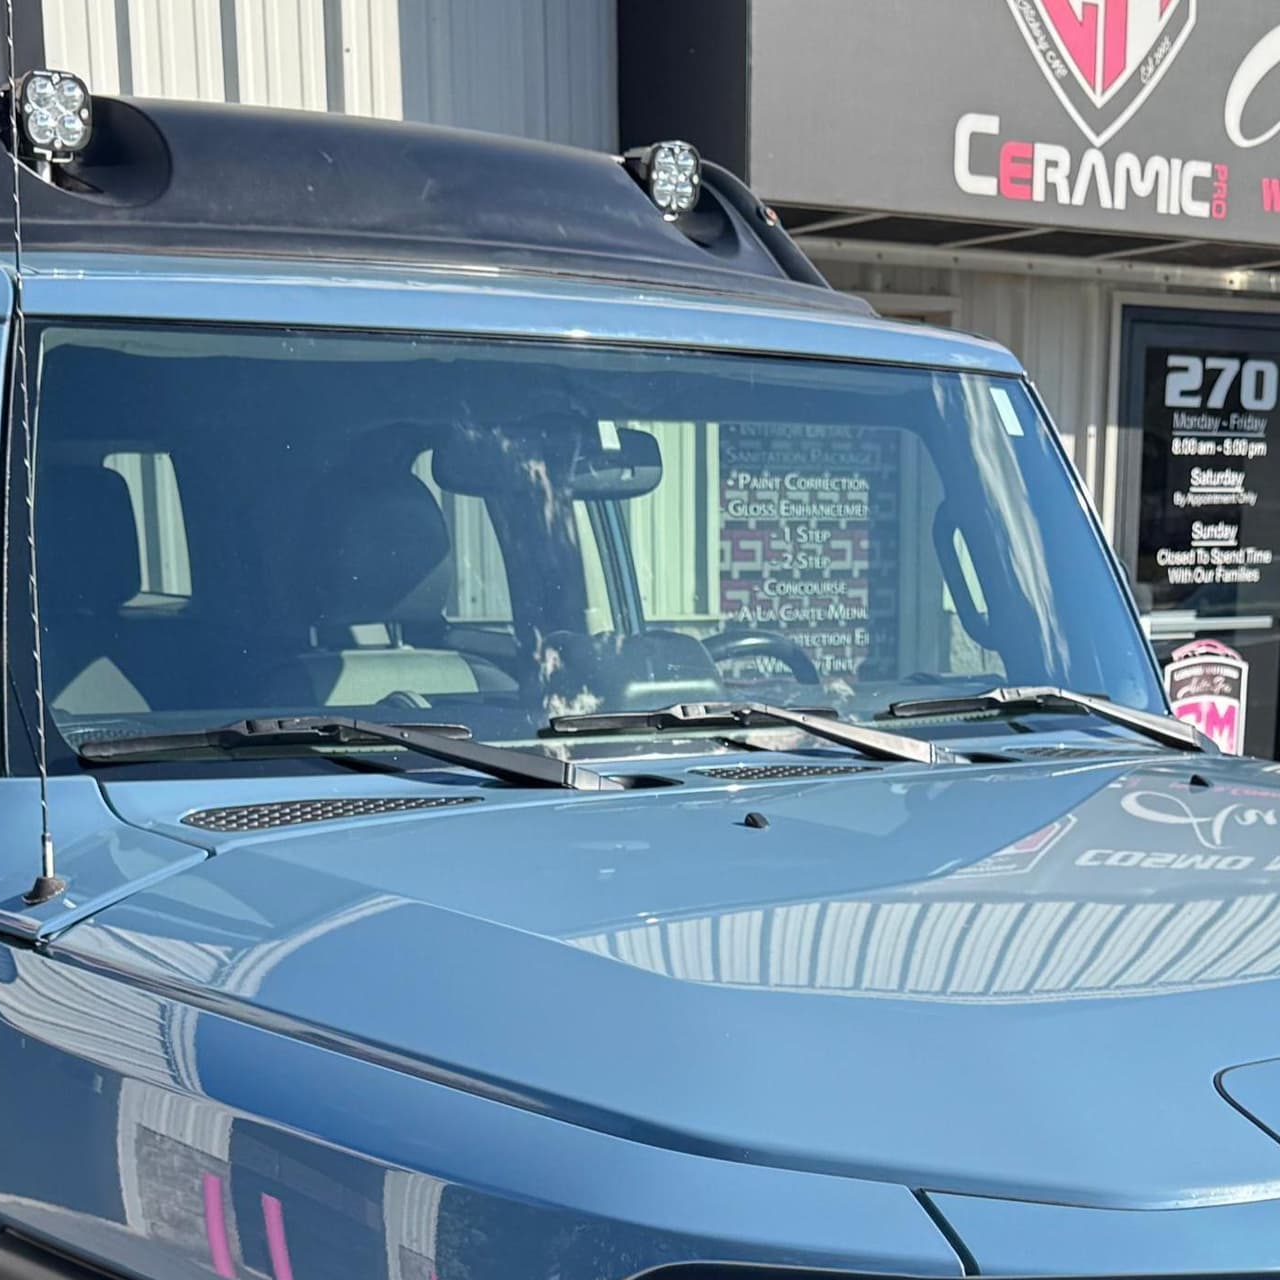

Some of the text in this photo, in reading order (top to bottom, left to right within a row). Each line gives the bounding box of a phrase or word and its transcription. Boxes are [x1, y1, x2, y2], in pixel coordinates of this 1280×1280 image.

[1212, 163, 1229, 221] PRO
[1164, 354, 1280, 411] 270
[1172, 411, 1220, 434] Monday
[1229, 412, 1268, 435] Friday
[738, 472, 869, 490] PAINT CORRECTION
[1190, 466, 1245, 490] Saturday
[727, 499, 872, 517] GLOSS ENHANCEMEN
[783, 525, 831, 543] 1 STEP
[1191, 520, 1238, 543] Sunday
[782, 552, 831, 570] 2 STEP
[1157, 546, 1272, 566] Closed To Spend Time
[1167, 565, 1260, 584] With Our Families
[763, 578, 848, 596] CONCOURSE
[738, 605, 752, 623] A
[779, 604, 825, 622] CARTE
